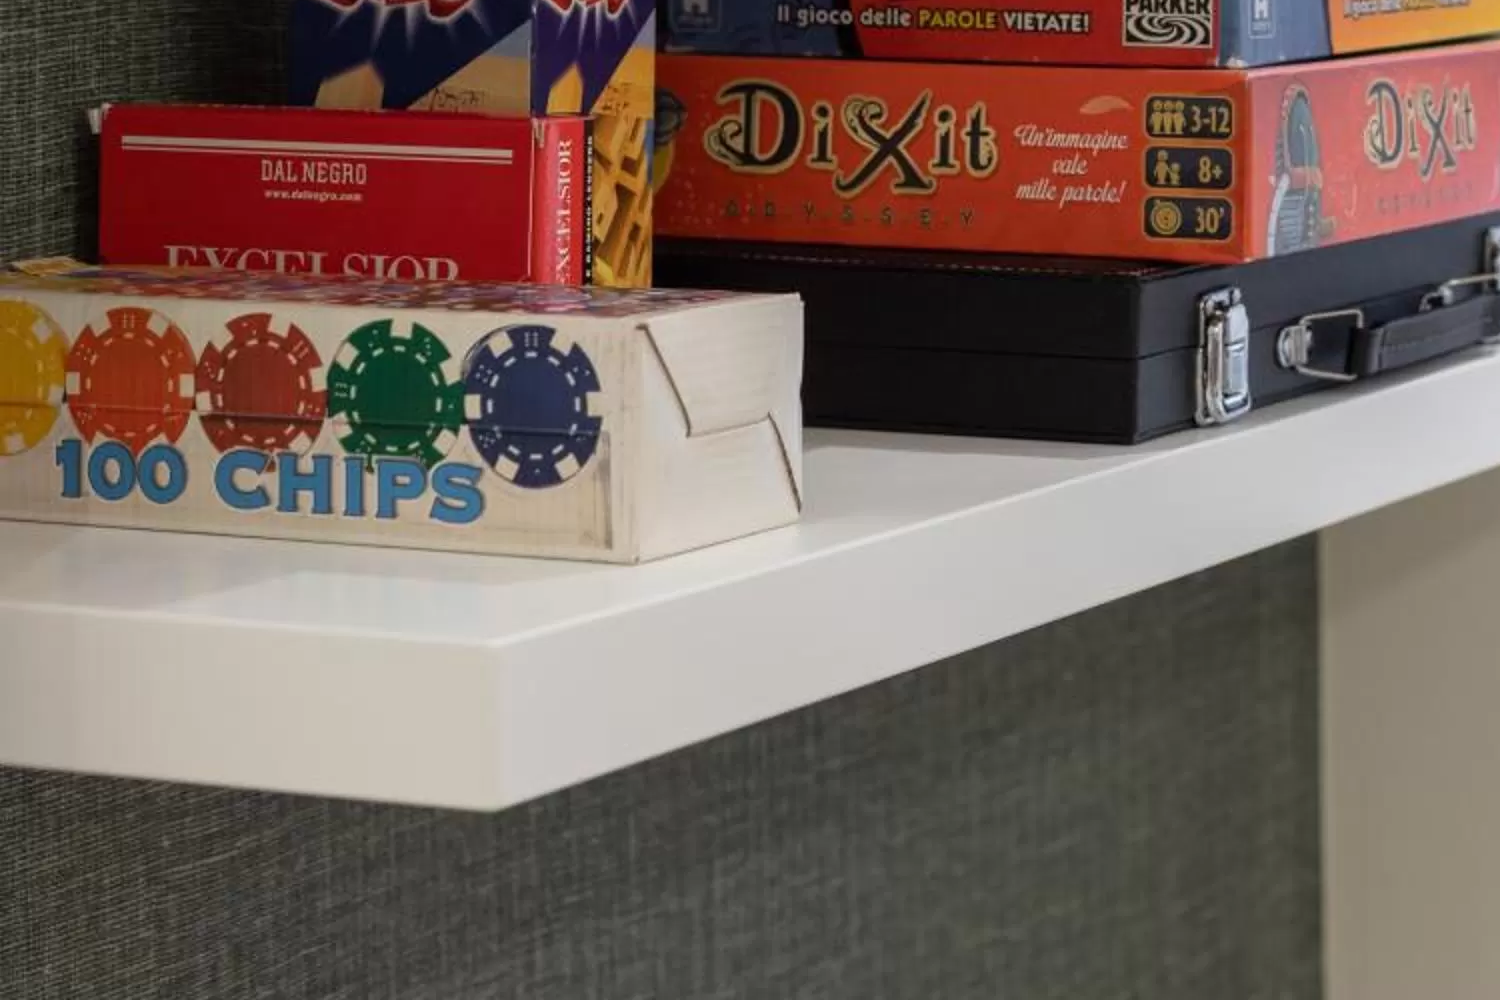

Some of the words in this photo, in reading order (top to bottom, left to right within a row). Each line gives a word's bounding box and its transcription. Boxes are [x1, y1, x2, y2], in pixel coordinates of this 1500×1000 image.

[799, 4, 853, 27] gioco
[860, 8, 911, 26] delle
[919, 10, 996, 29] PAROLE
[1004, 11, 1089, 33] VIETATE!
[1191, 105, 1230, 133] 3-12
[1014, 124, 1129, 156] Un'immagine
[261, 159, 298, 182] DAL
[302, 160, 367, 185] NEGRO
[1052, 150, 1088, 175] vale
[1198, 155, 1224, 185] 8+
[1016, 178, 1057, 201] mille
[1059, 180, 1127, 209] parole!
[556, 139, 572, 284] EXCELSIOR
[164, 244, 460, 281] EXCELSIOR
[56, 439, 190, 505] 100
[213, 448, 486, 524] CHIPS
